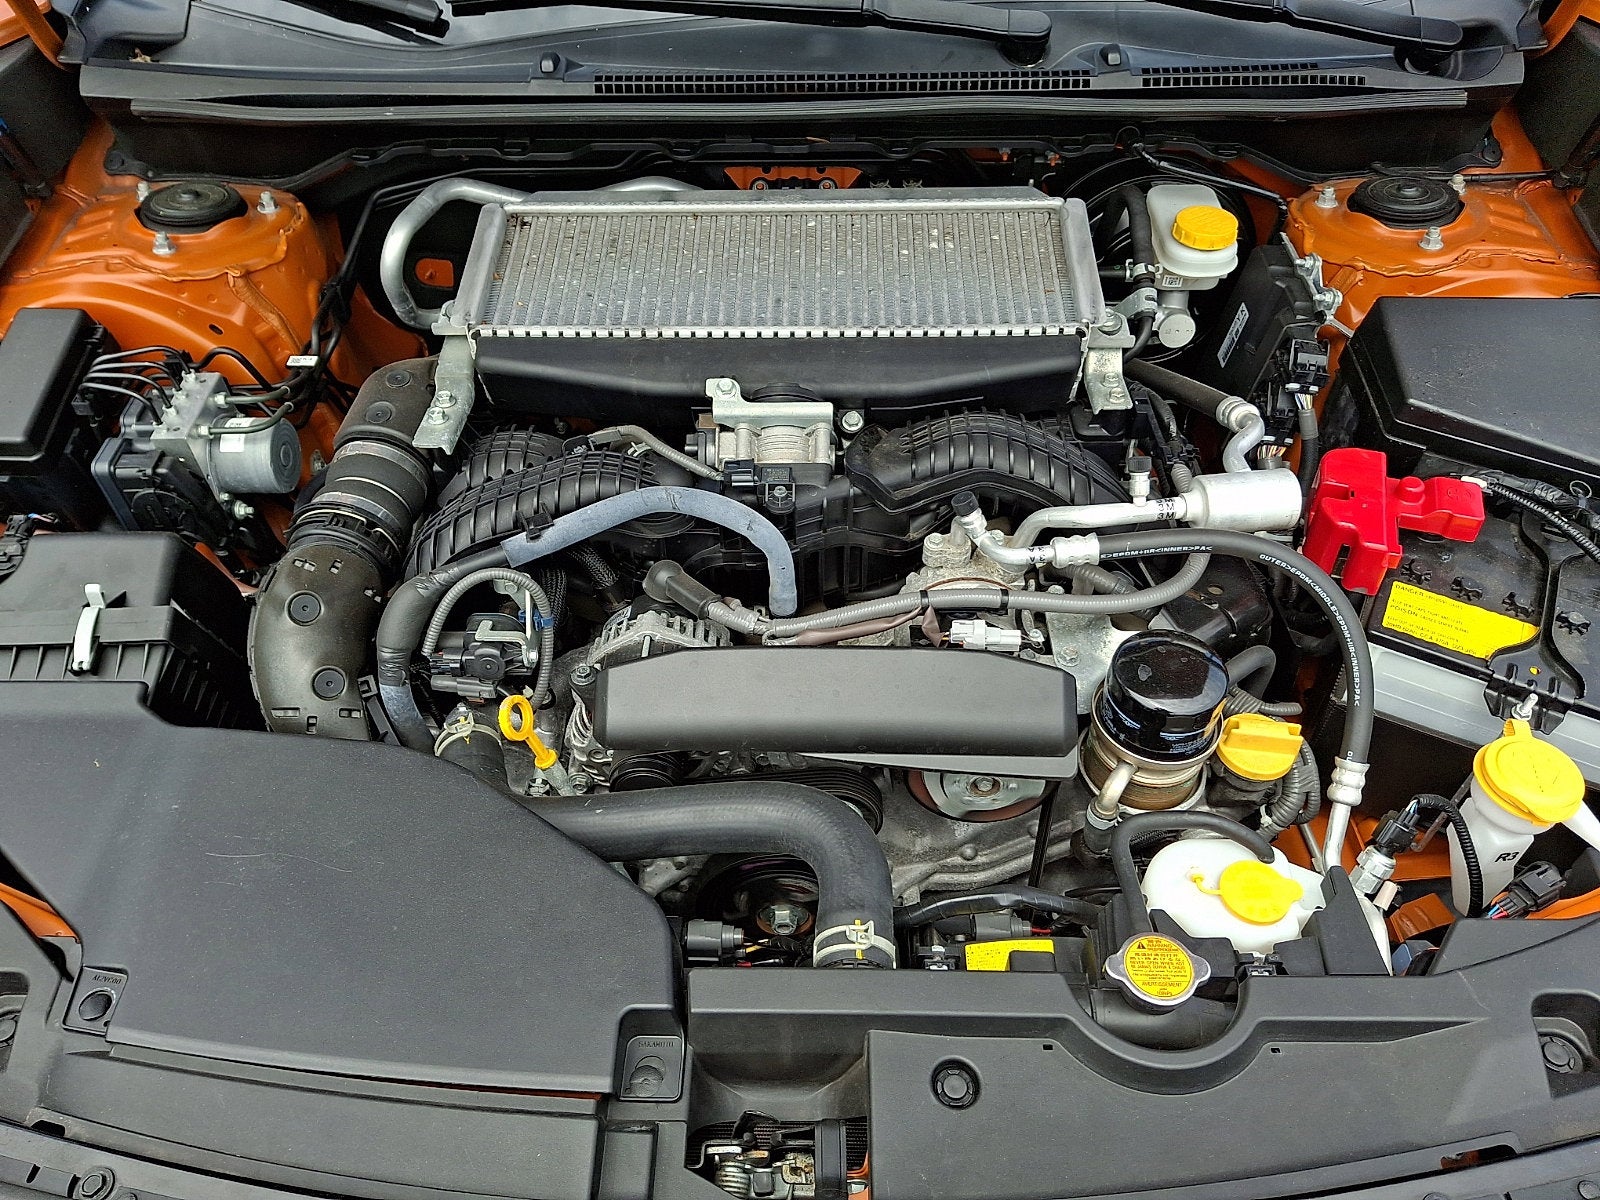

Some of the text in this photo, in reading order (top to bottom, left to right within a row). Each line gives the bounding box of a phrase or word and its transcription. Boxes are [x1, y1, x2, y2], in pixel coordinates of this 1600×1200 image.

[1395, 584, 1424, 597] DANGER
[1390, 603, 1418, 617] POISON
[1494, 851, 1520, 862] R3
